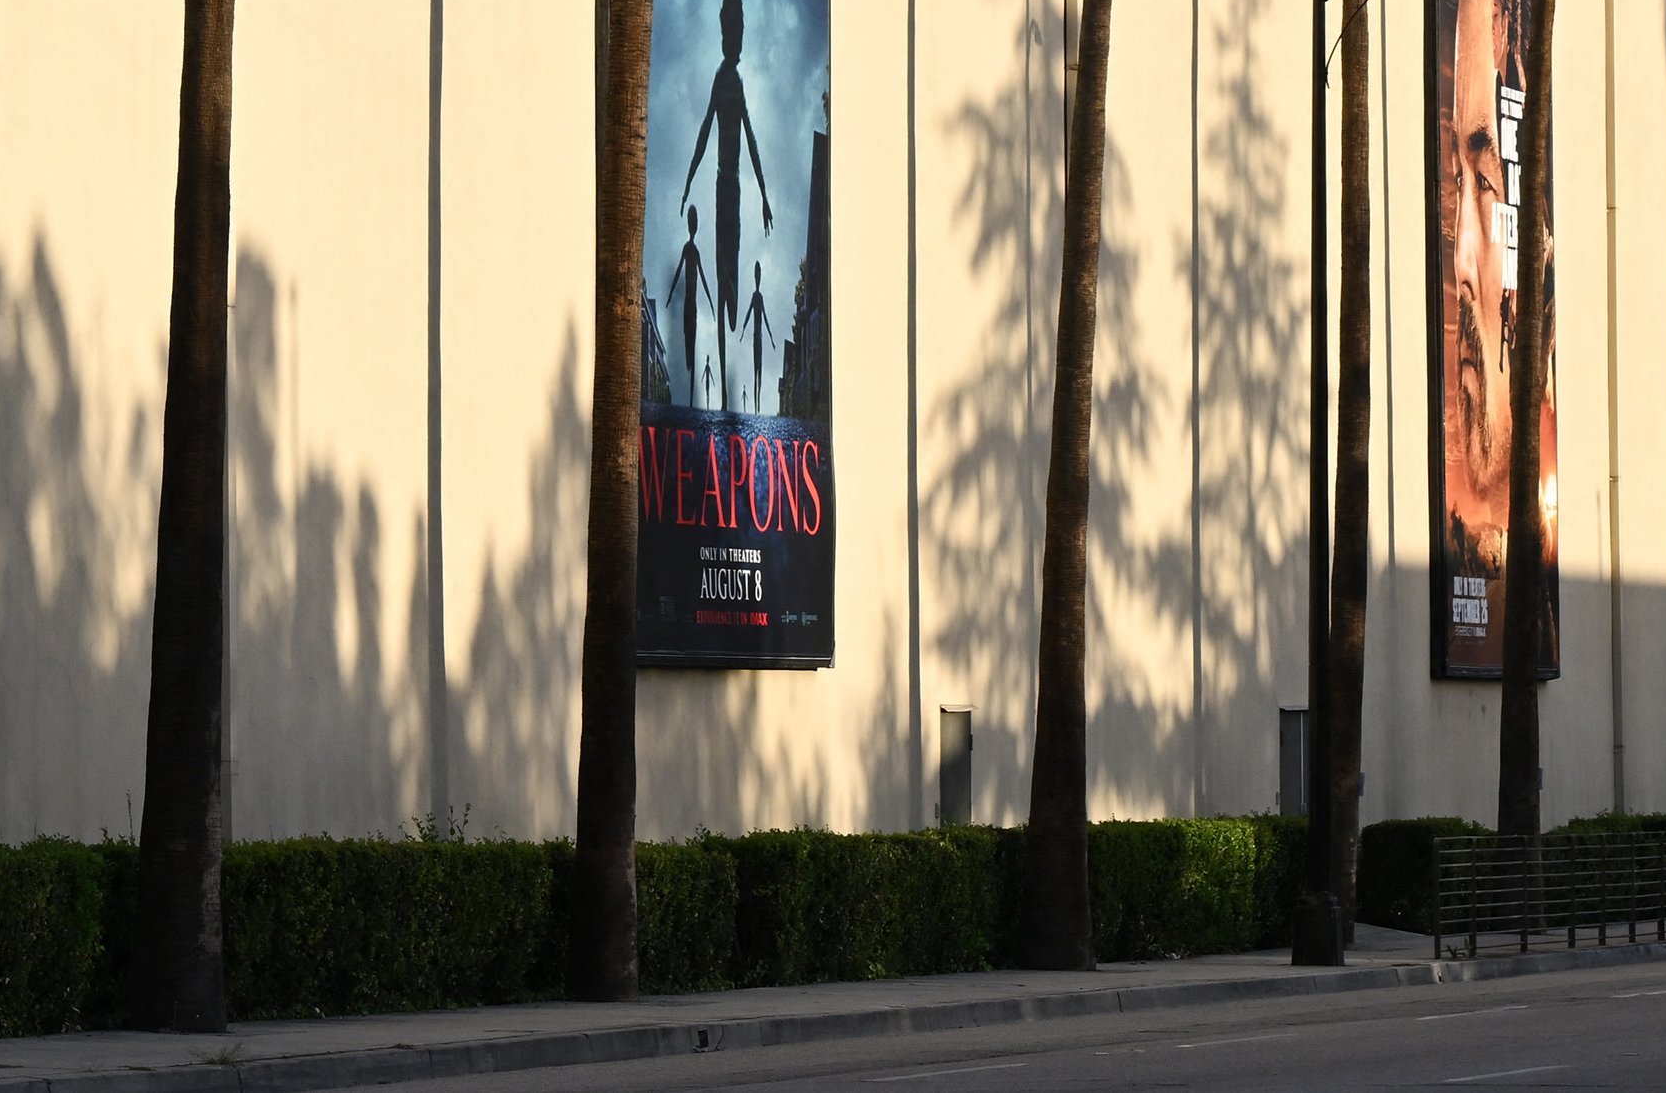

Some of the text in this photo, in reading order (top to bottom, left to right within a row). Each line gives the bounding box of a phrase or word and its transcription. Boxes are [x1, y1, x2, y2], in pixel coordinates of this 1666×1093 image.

[639, 426, 822, 536] WEAPONS
[700, 546, 762, 564] ONLY IN THEATERS
[699, 567, 763, 602] AUGUST 8
